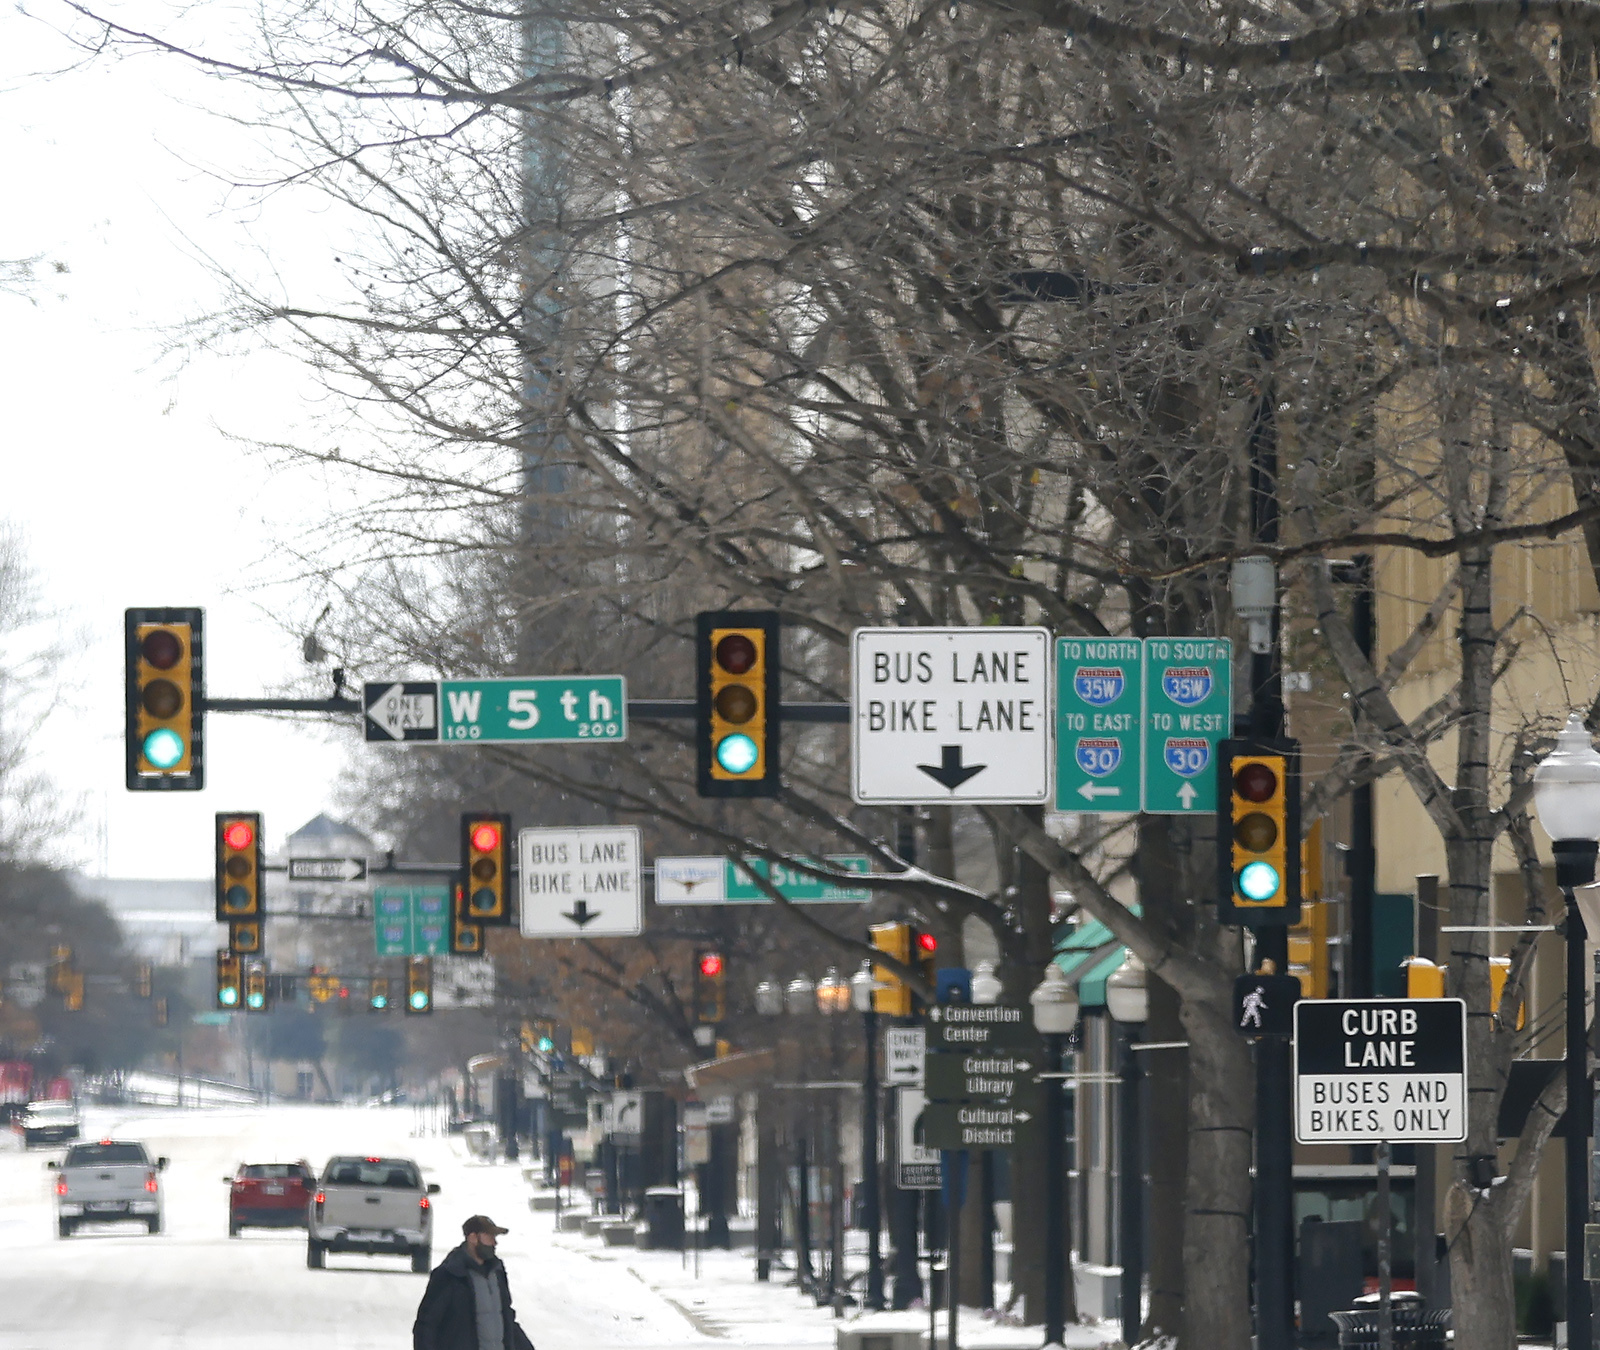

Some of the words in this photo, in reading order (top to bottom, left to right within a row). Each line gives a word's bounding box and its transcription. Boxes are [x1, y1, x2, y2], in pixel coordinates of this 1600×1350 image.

[1062, 643, 1081, 660] TO
[1086, 643, 1137, 660] NORTH
[1150, 643, 1169, 660] TO
[1174, 643, 1229, 660] SOUTH
[874, 652, 933, 683] BUS
[952, 652, 1030, 683] LANE
[1082, 679, 1116, 699] 35W
[1170, 679, 1204, 699] 35W
[386, 697, 422, 712] ONE
[447, 690, 482, 723] W
[386, 712, 424, 728] WAY
[869, 700, 937, 731] BIKE
[958, 700, 1035, 731] LANE
[1066, 713, 1084, 731] TO
[1094, 713, 1132, 731] EAST
[1153, 713, 1171, 731] TO
[1179, 714, 1223, 731] WEST
[447, 725, 481, 739] 100
[578, 722, 620, 738] 200
[1084, 750, 1113, 770] 30
[1172, 750, 1202, 770] 30
[532, 843, 568, 864] BUS
[580, 841, 626, 863] LANE
[530, 872, 571, 894] BIKE
[583, 871, 630, 893] LANE
[944, 1006, 1021, 1022] Convention
[1342, 1009, 1418, 1035] CURB
[944, 1027, 989, 1042] Center
[894, 1049, 921, 1060] WAY
[1344, 1041, 1416, 1067] LANE
[964, 1057, 1014, 1073] Central
[966, 1077, 1013, 1096] Library
[1314, 1082, 1389, 1104] BUSES
[1402, 1081, 1448, 1103] AND
[958, 1109, 1014, 1124] Cultural
[1311, 1110, 1379, 1132] BIKES
[1394, 1109, 1450, 1132] ONLY
[963, 1128, 1014, 1144] District
